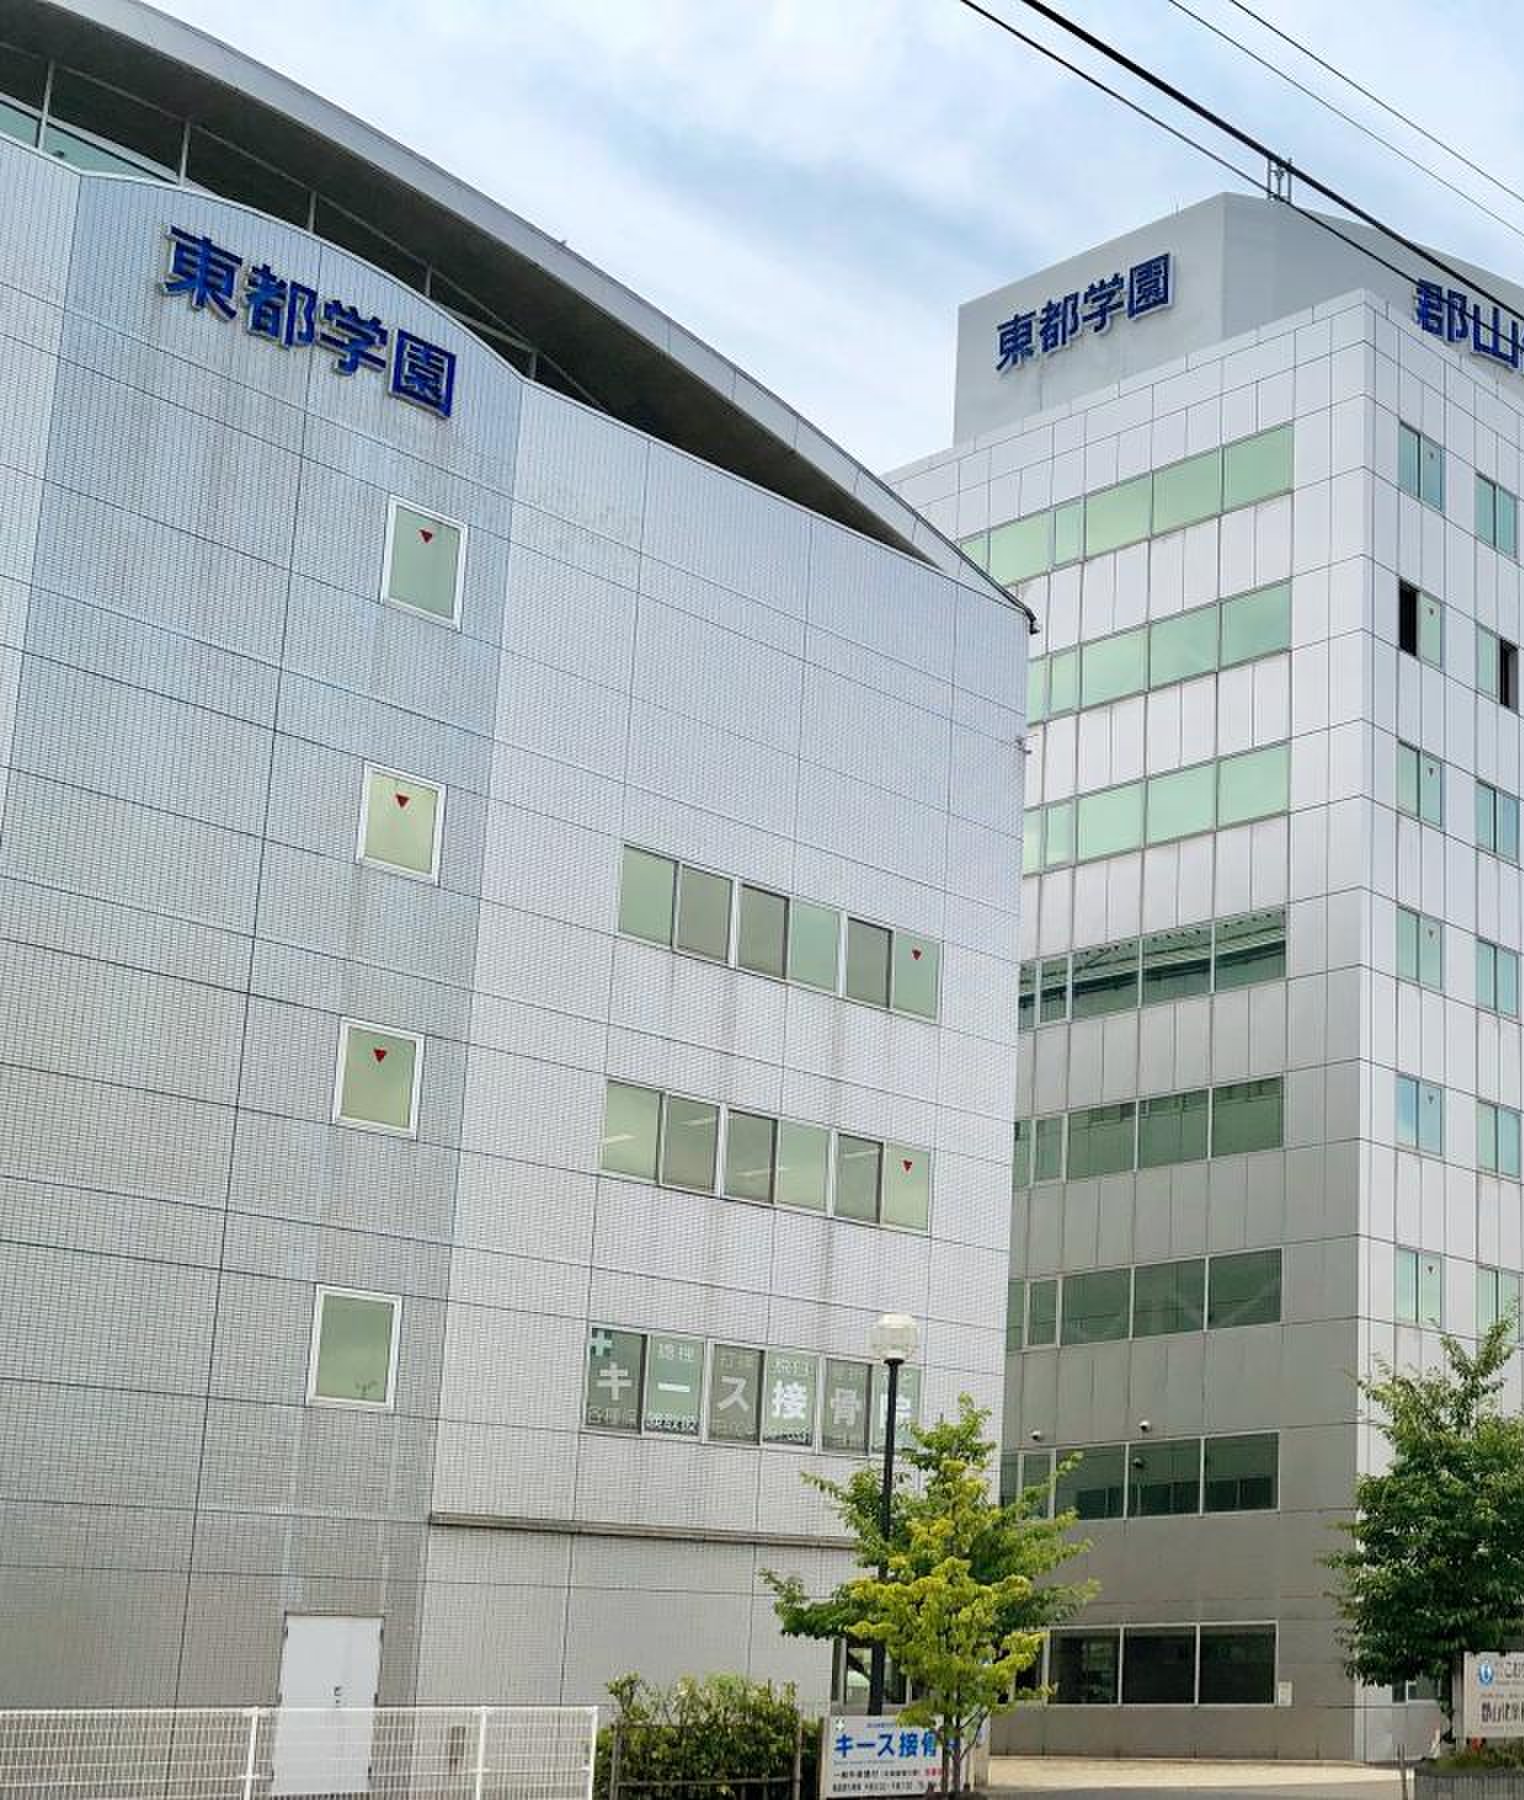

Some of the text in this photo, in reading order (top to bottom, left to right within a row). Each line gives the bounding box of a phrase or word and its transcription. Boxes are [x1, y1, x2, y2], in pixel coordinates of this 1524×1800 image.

[161, 225, 457, 418] 東都学園
[996, 252, 1171, 369] 東都学園
[834, 1730, 959, 1758] キース接骨
